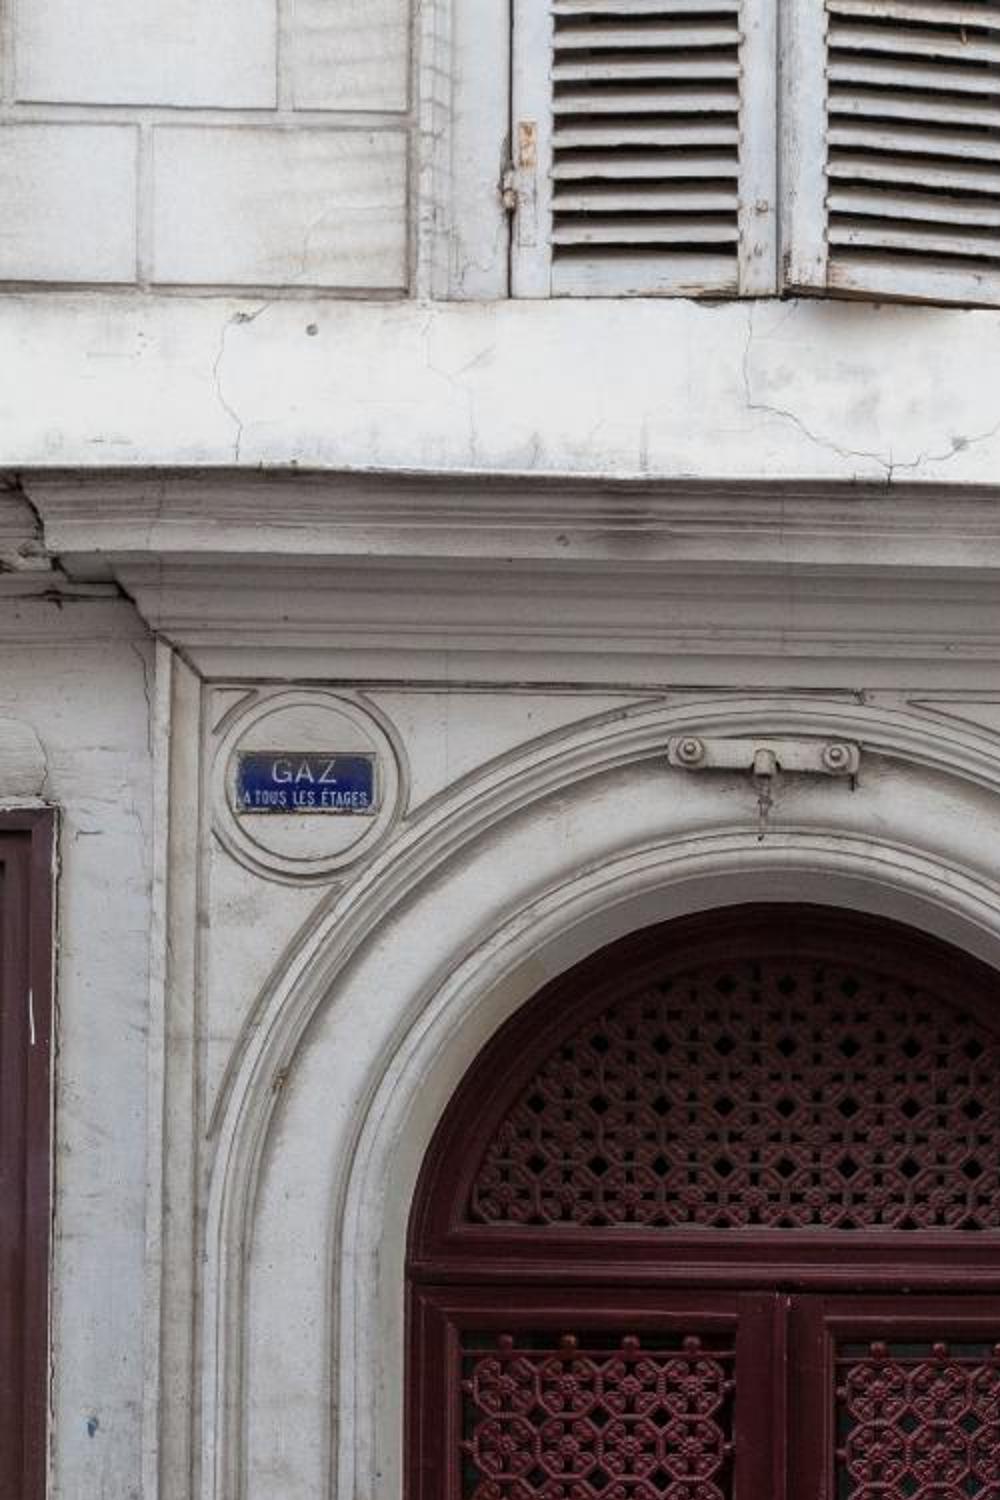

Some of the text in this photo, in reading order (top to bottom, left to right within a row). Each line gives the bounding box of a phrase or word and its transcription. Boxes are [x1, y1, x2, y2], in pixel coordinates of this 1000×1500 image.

[271, 759, 337, 783] GAZ
[255, 790, 287, 806] TOUS
[293, 789, 315, 805] LES
